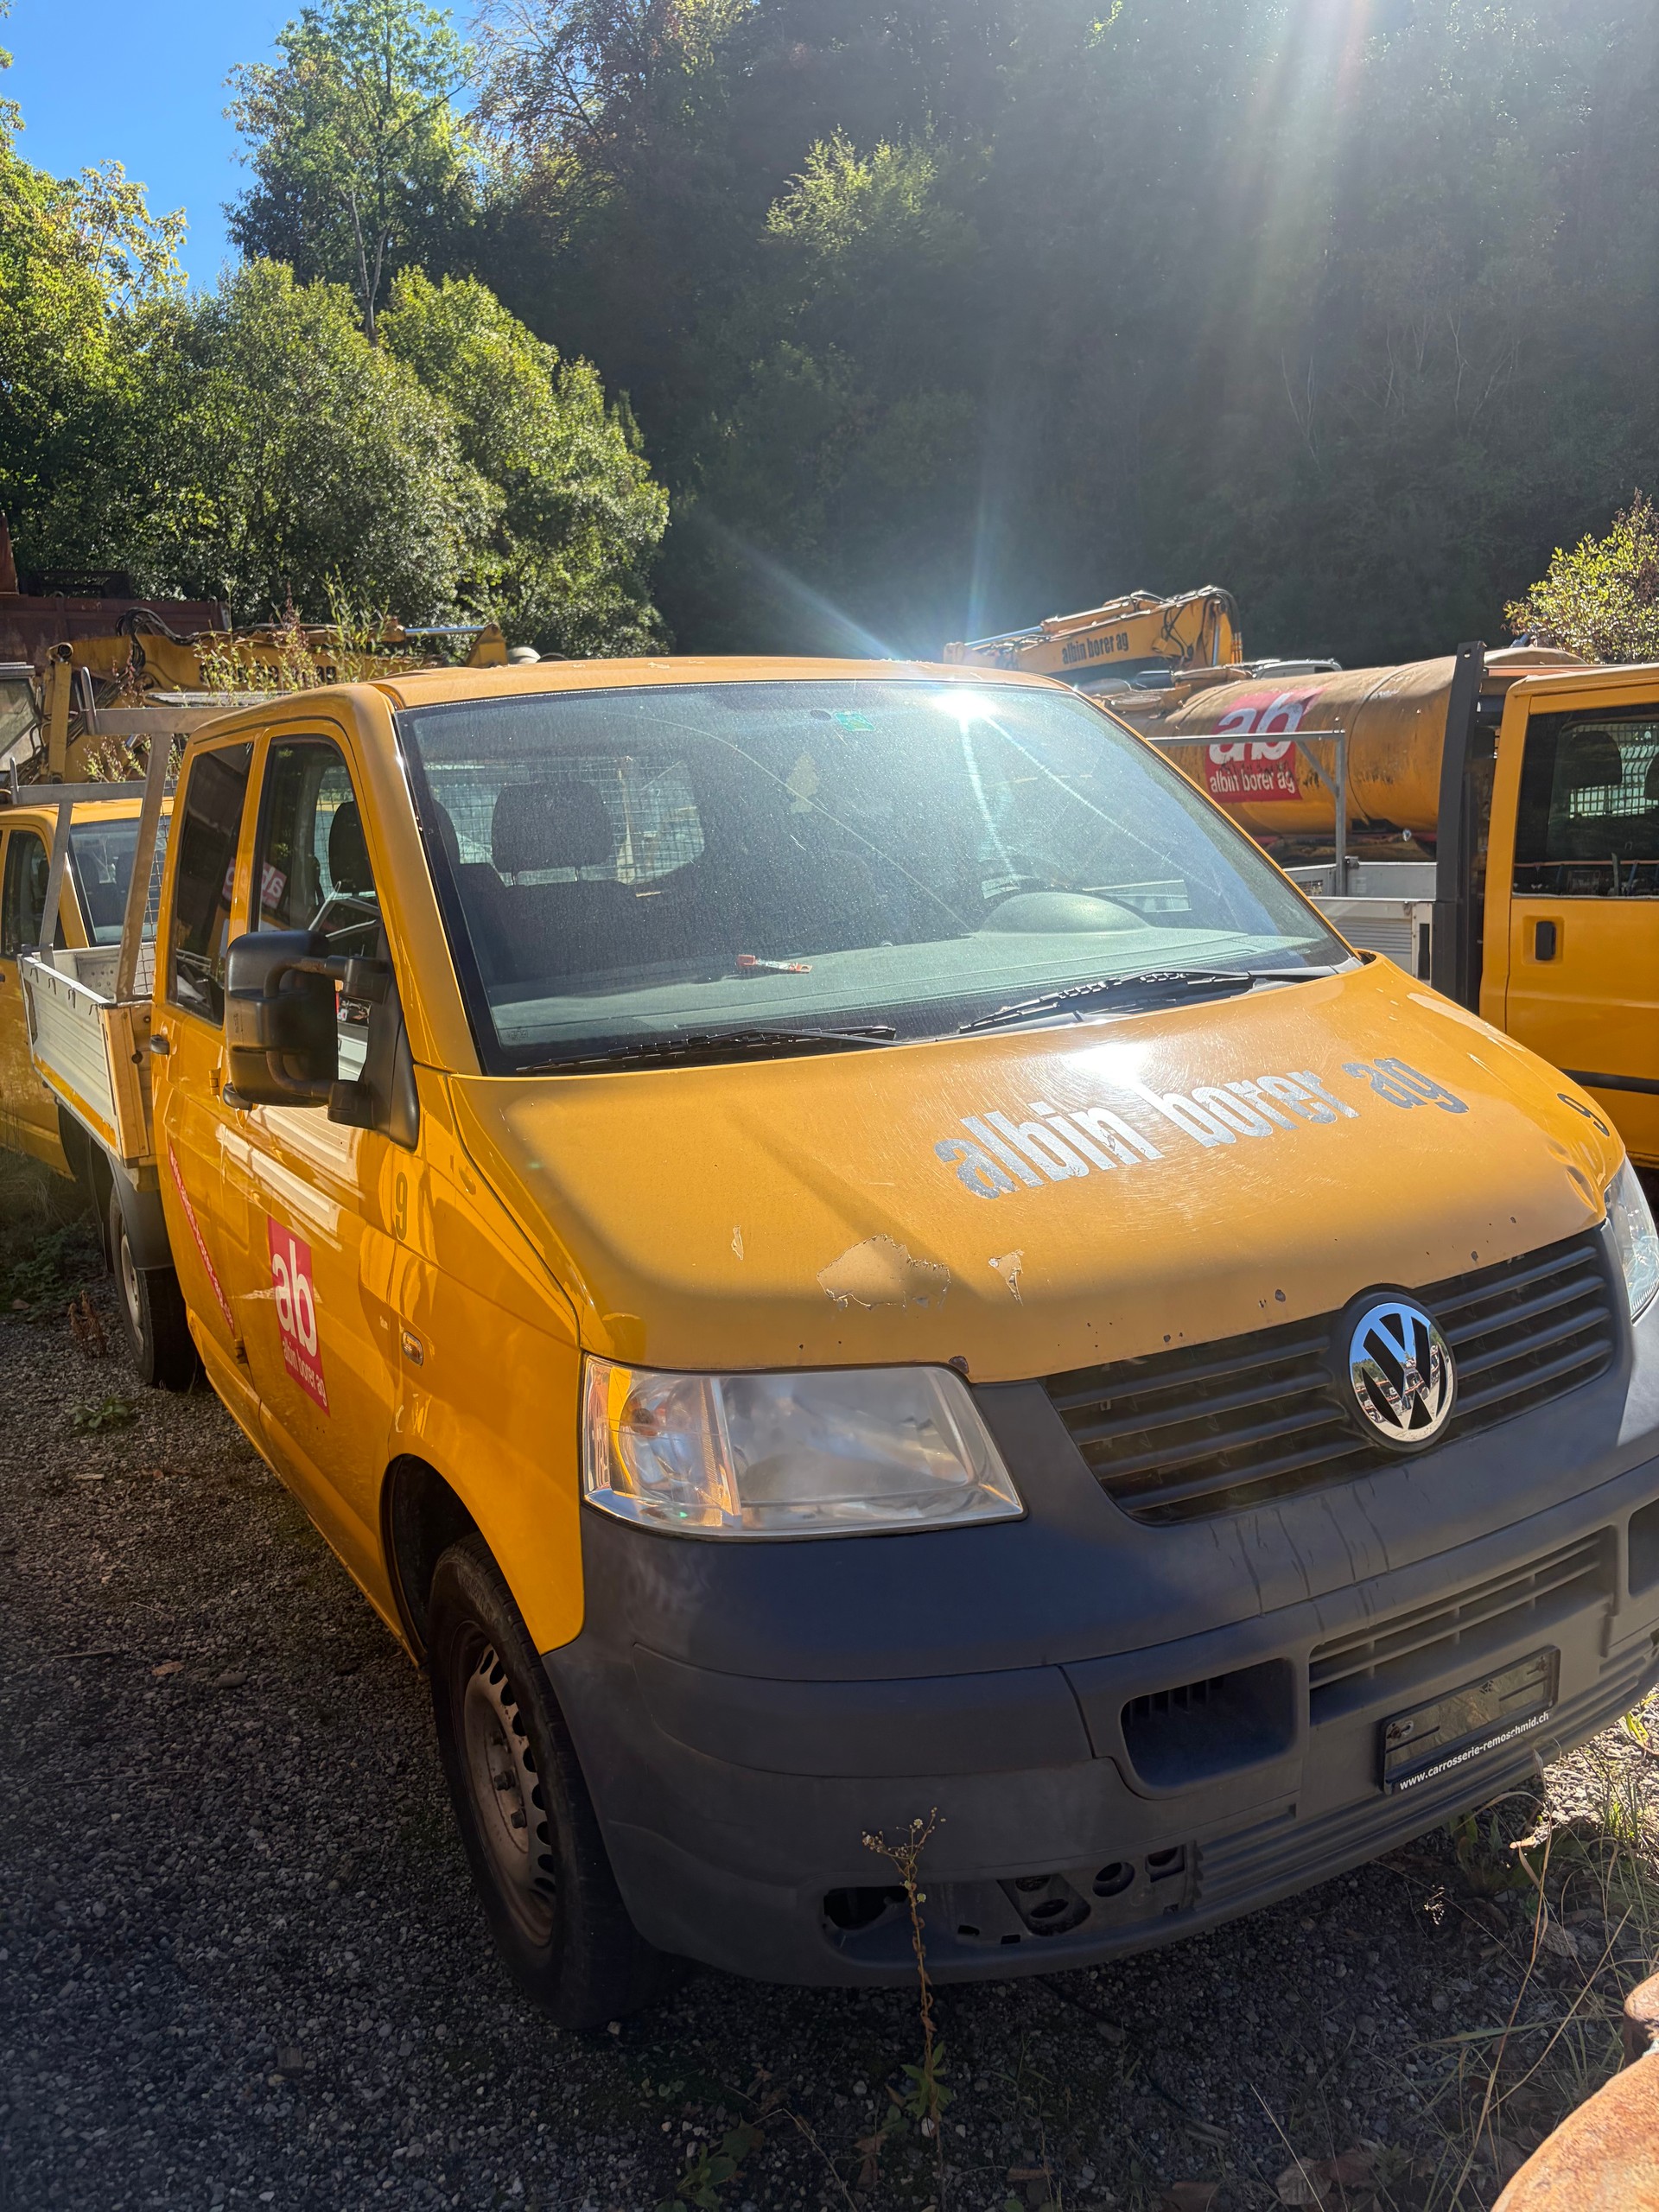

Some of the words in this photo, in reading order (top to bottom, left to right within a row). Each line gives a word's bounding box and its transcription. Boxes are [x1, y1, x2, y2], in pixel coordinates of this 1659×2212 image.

[1062, 641, 1087, 664] albin
[1087, 636, 1115, 658] borer
[1116, 632, 1128, 652] ag
[1209, 692, 1303, 765] ab
[1210, 770, 1240, 793] albin
[1241, 769, 1274, 791] borer
[1277, 770, 1295, 794] ag
[934, 1098, 1164, 1199] albin
[1125, 1070, 1360, 1147] borer
[1342, 1058, 1469, 1114] ag
[395, 1172, 408, 1241] 9
[272, 1238, 317, 1357] ab
[315, 1372, 327, 1407] ag
[1399, 1712, 1549, 1790] www.carrosserie-remoschmid.ch
